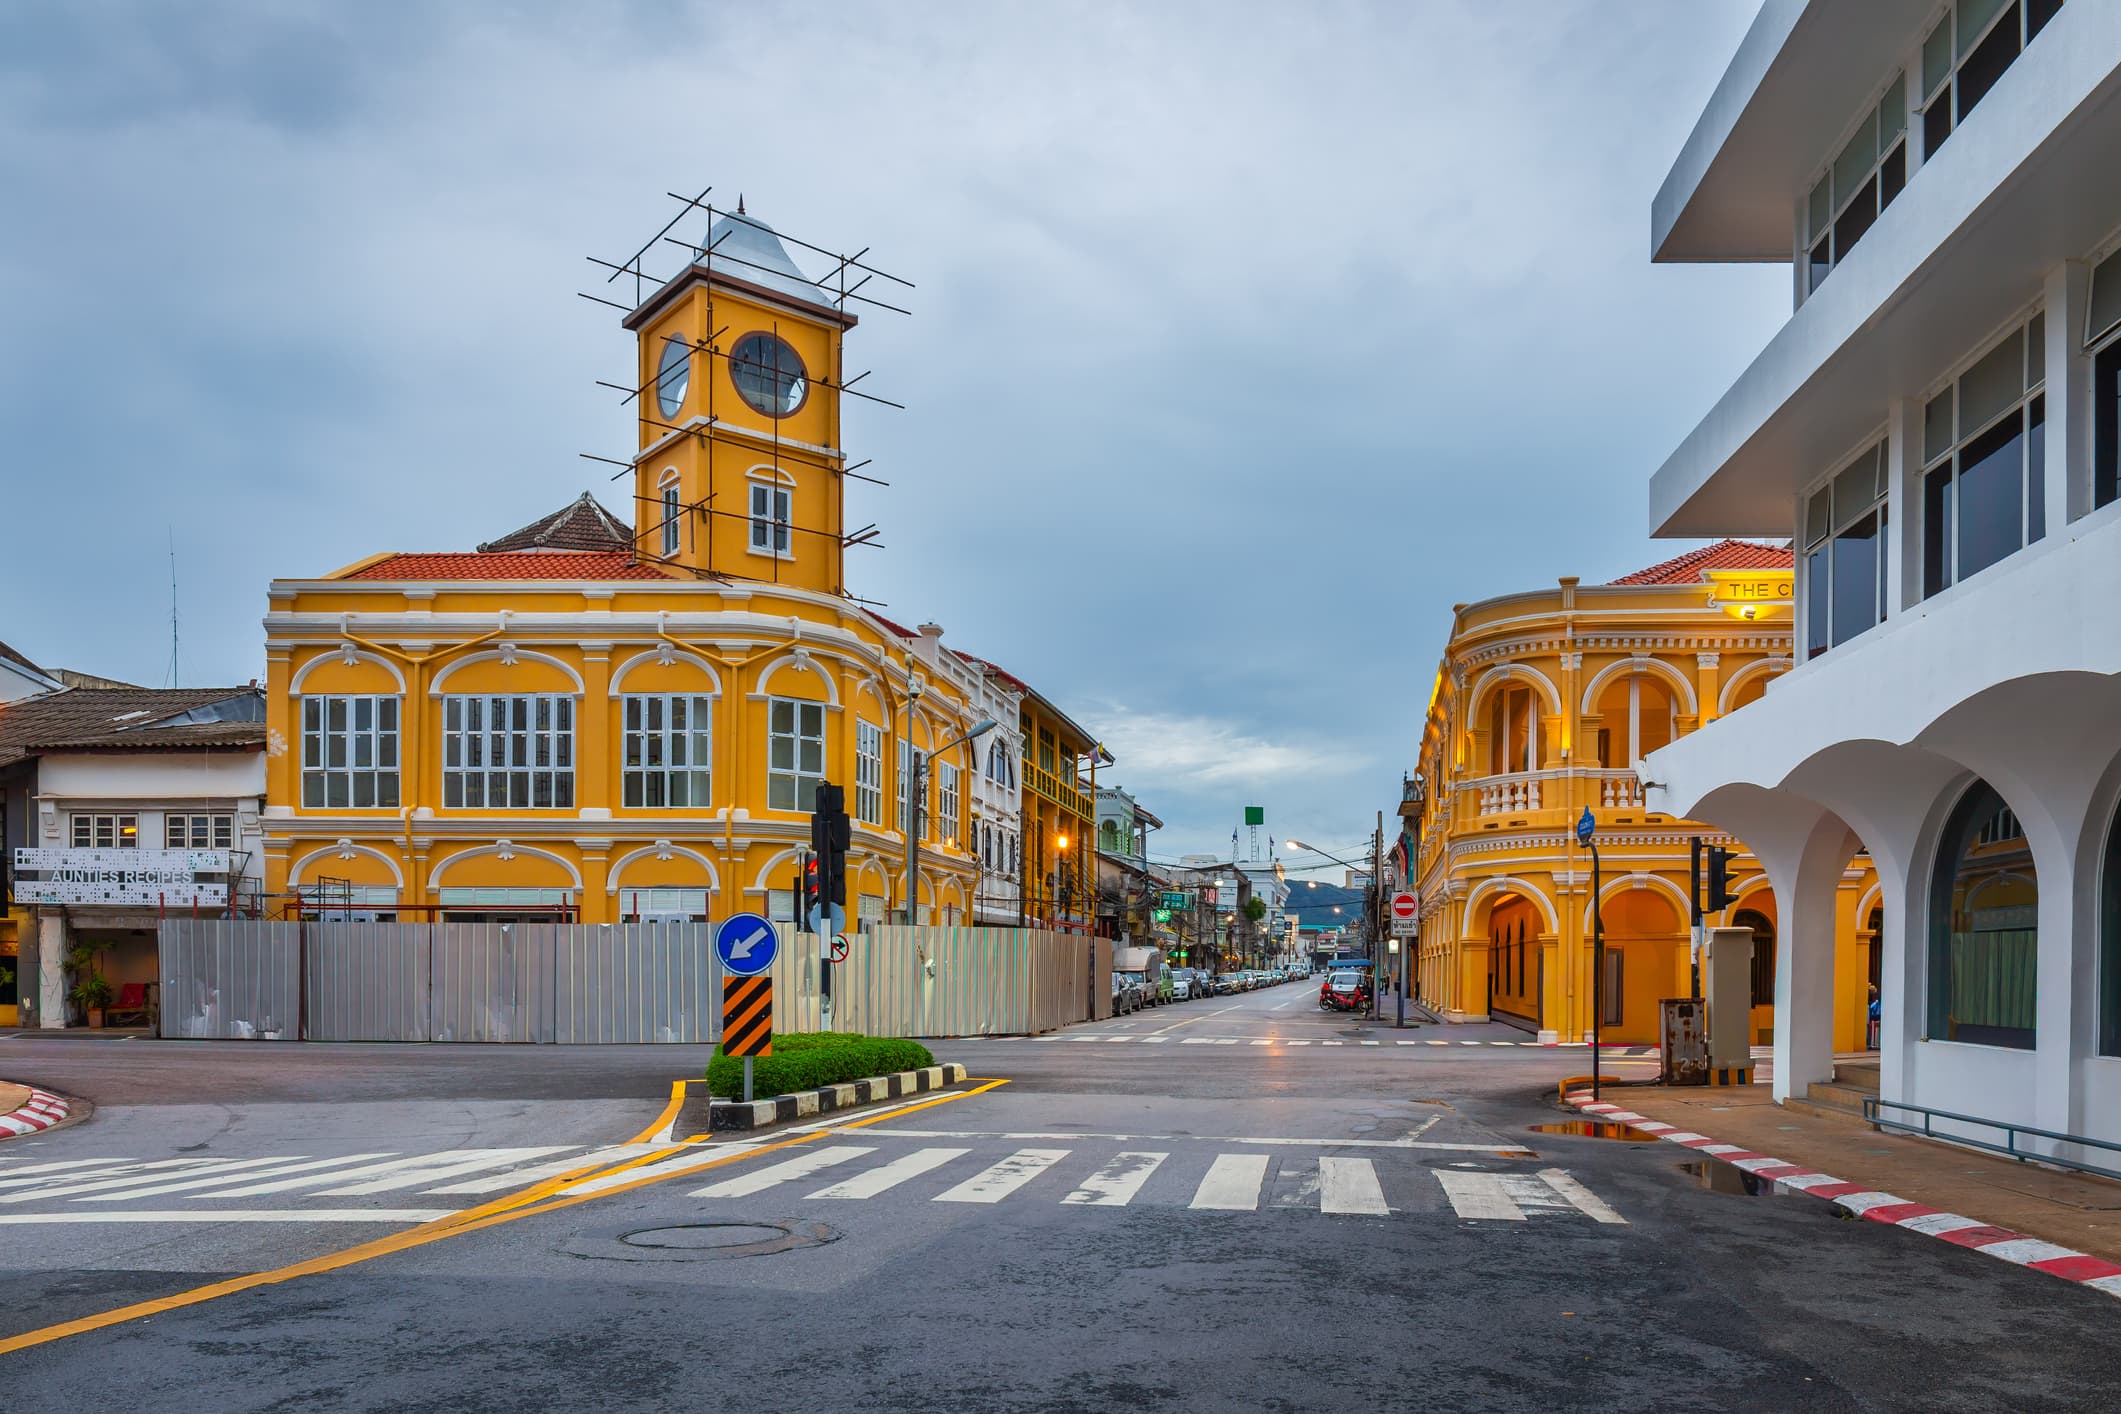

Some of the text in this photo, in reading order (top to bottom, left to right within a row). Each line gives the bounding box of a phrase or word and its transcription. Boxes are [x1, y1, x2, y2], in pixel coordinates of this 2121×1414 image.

[1729, 583, 1795, 597] THE C
[51, 870, 192, 884] AUNTIES RECIPES
